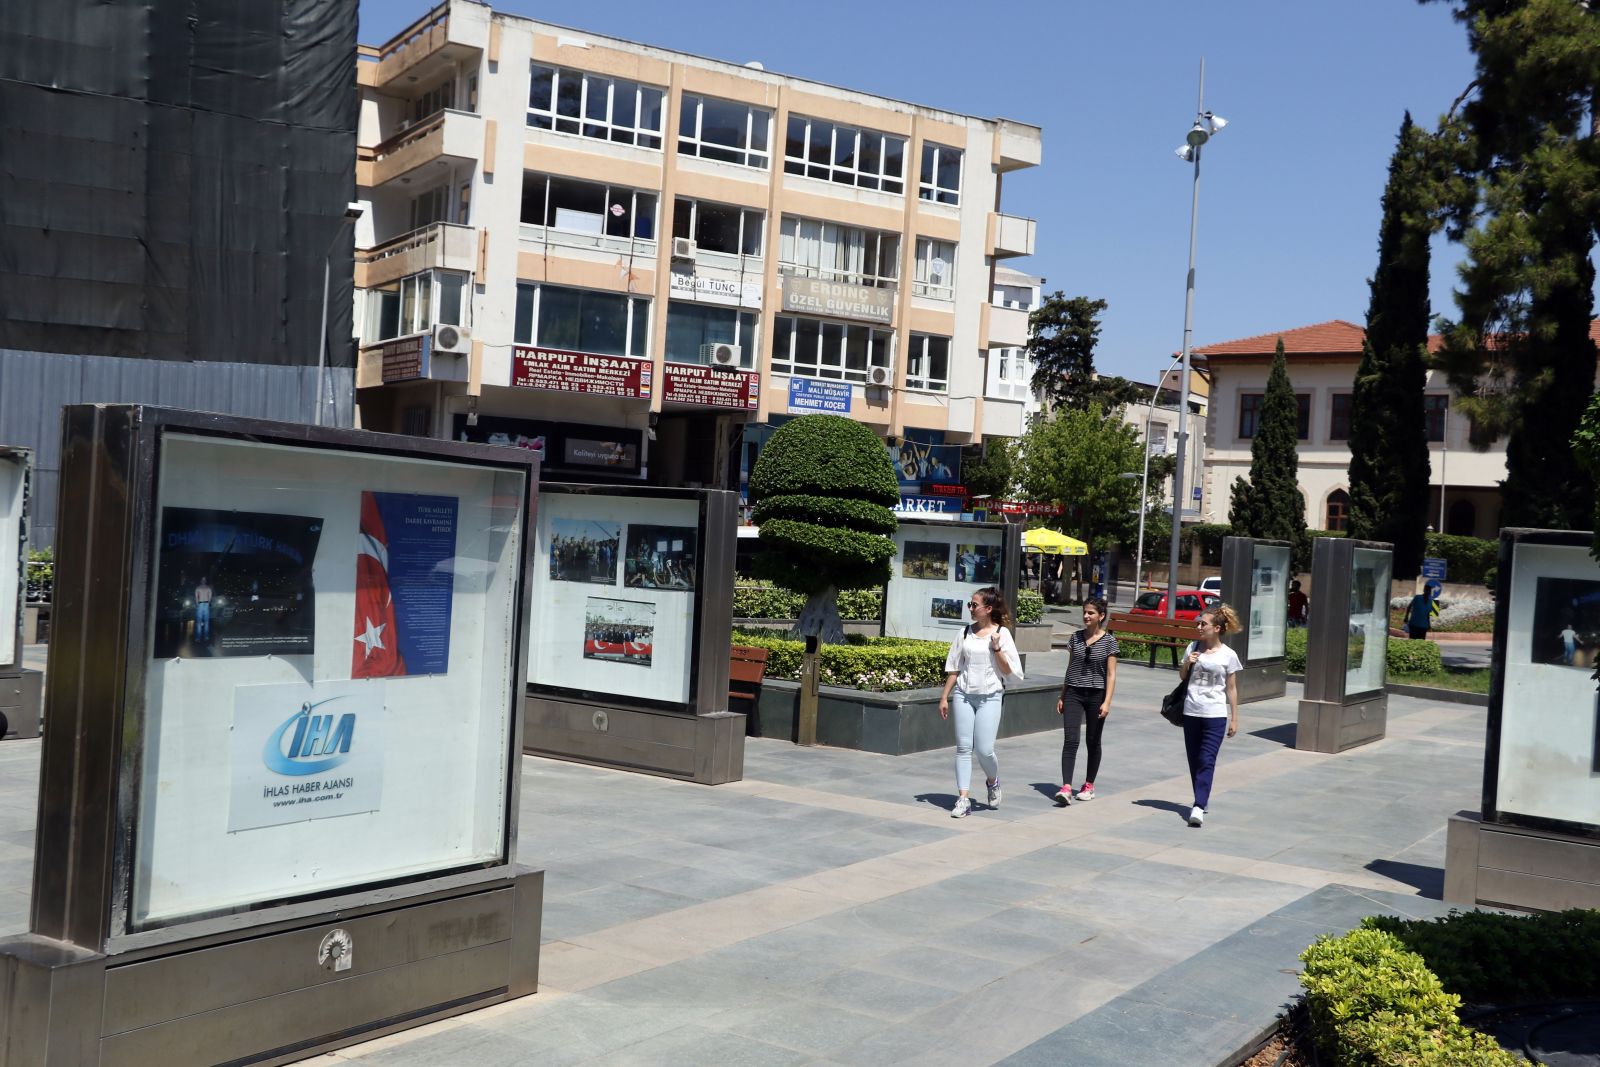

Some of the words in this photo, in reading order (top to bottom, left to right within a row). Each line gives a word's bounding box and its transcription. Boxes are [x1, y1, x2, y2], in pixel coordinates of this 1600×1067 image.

[789, 292, 823, 307] ÖZEL
[515, 349, 577, 364] HARPUT
[583, 355, 639, 370] İNŞAAT
[523, 360, 549, 369] EMLAK
[552, 363, 571, 371] ALIM
[573, 365, 596, 373] SATIM
[665, 365, 707, 378] HARPUT
[794, 397, 823, 408] MEHMET
[823, 400, 846, 410] KOÇER
[888, 497, 946, 513] ARKET
[263, 785, 290, 798] İHLAS
[292, 781, 321, 794] HABER
[322, 777, 354, 790] AJANSI
[272, 792, 345, 808] www.iha.com.tr
